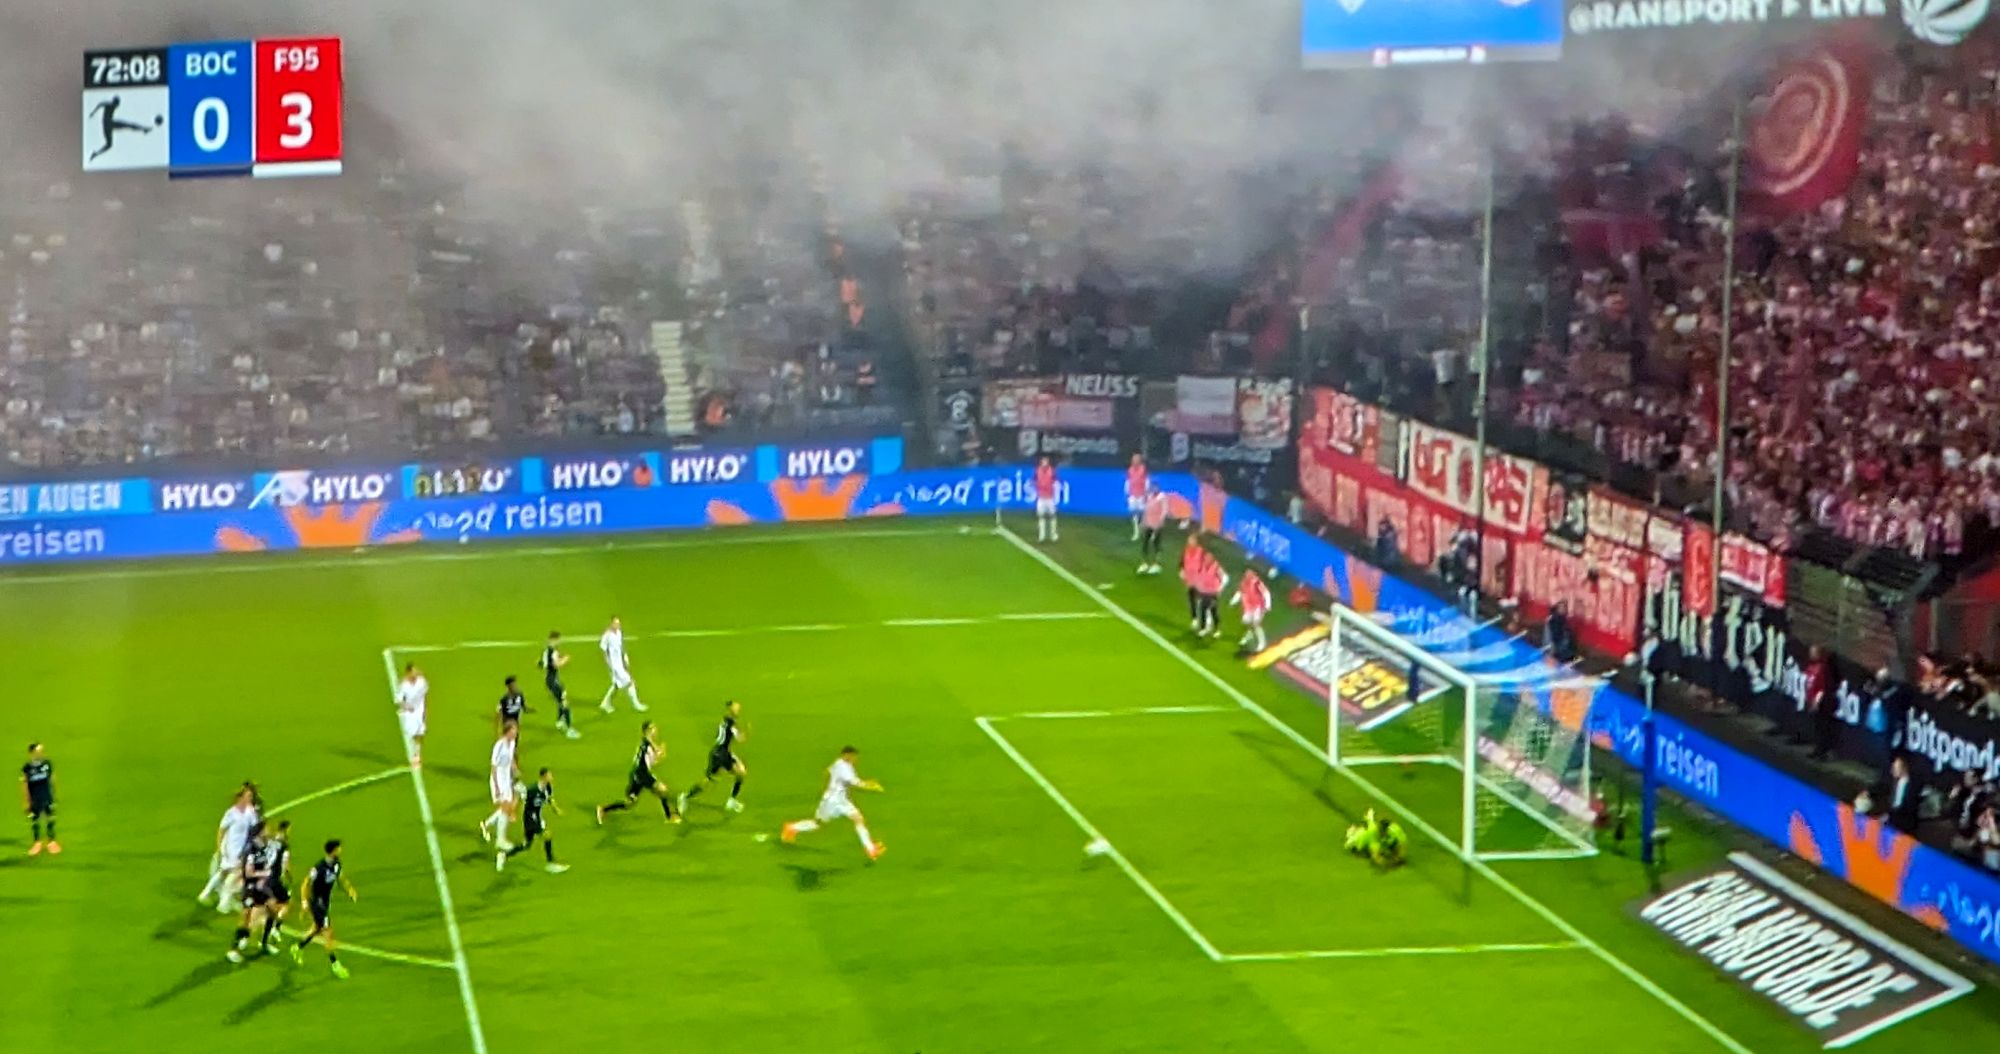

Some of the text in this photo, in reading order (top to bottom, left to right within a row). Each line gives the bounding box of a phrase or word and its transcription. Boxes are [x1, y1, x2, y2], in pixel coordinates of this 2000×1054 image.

[1065, 375, 1139, 397] NEUSS
[553, 461, 622, 490] HYLO
[787, 447, 857, 476] HYLO
[37, 482, 121, 512] AUGEN
[162, 482, 237, 511] HYLO
[313, 474, 384, 503] HYLO
[505, 495, 603, 531] reisen
[0, 521, 105, 558] reisen
[1656, 731, 1719, 799] reisen
